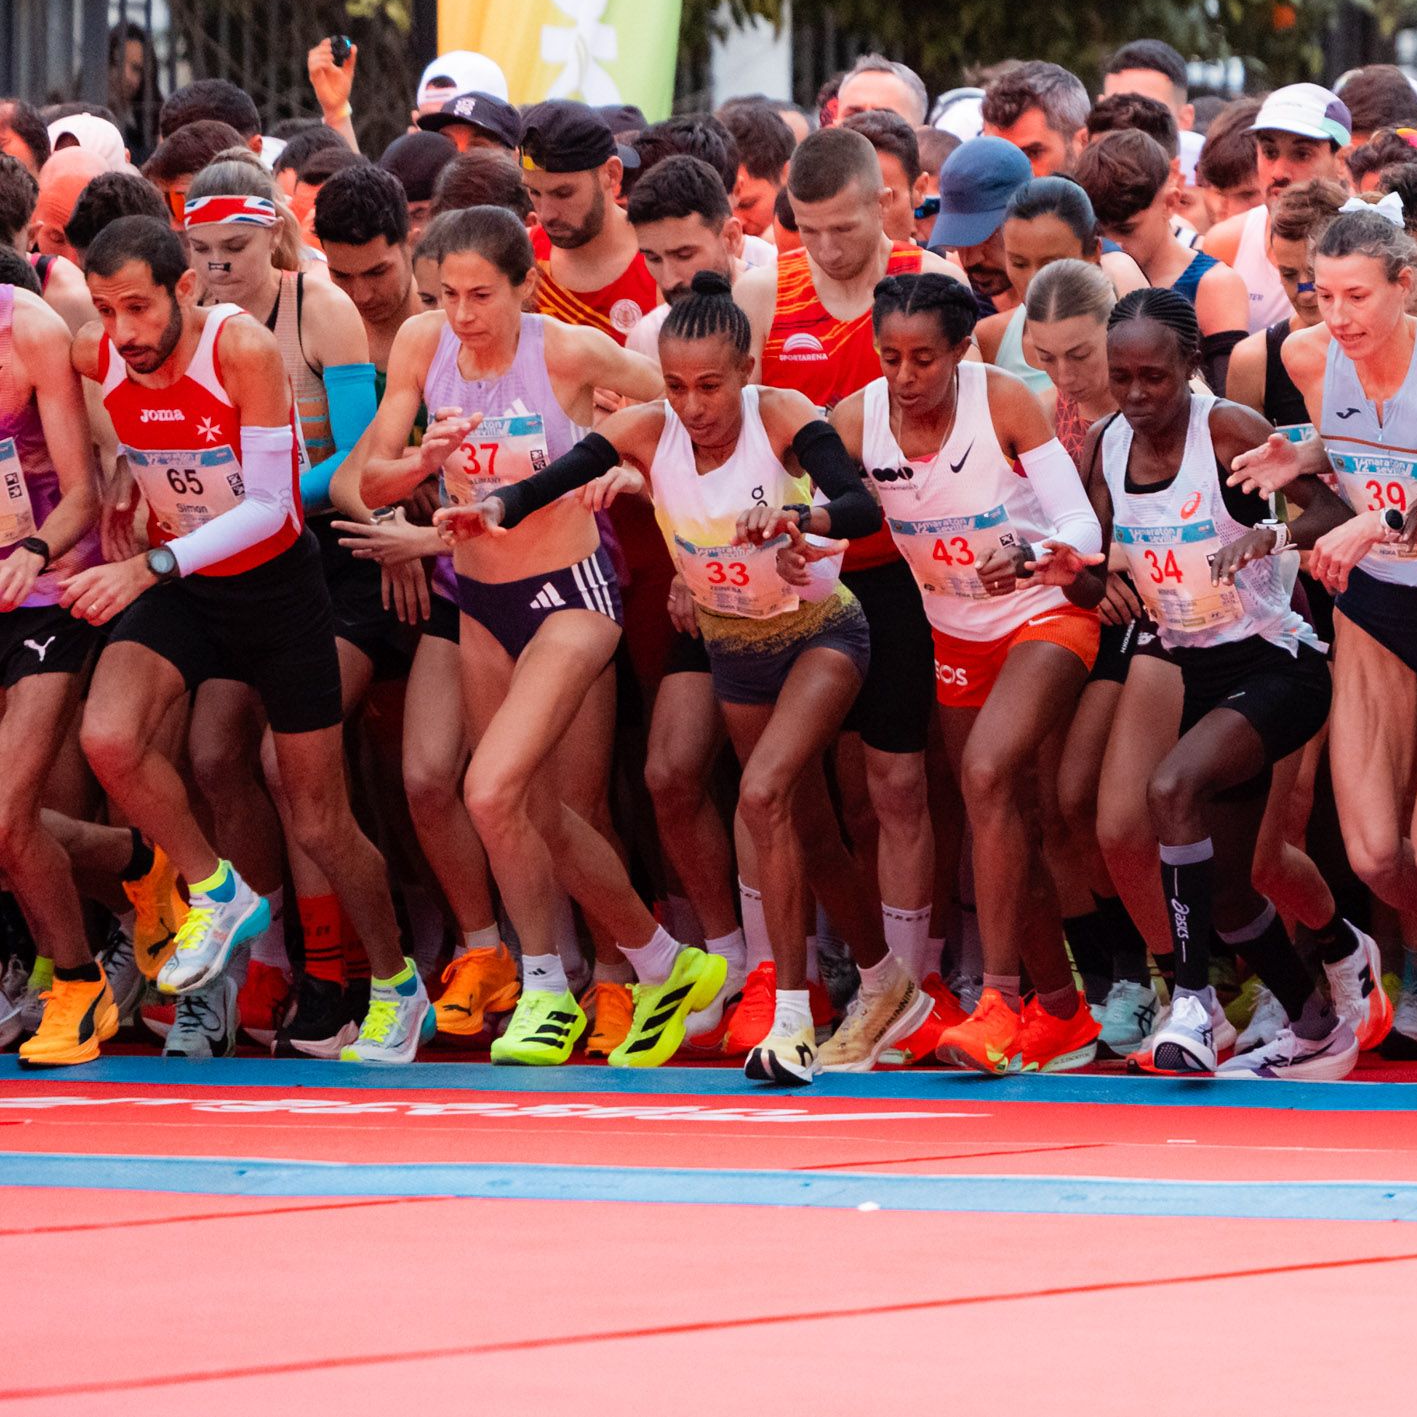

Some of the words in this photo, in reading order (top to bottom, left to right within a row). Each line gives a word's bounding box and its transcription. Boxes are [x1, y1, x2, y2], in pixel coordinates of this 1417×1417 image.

[460, 442, 499, 476] 37
[166, 468, 204, 496] 65
[1365, 480, 1407, 512] 39
[176, 502, 208, 514] Simon
[932, 536, 975, 567] 43
[1143, 549, 1184, 584] 34
[705, 561, 750, 586] 33
